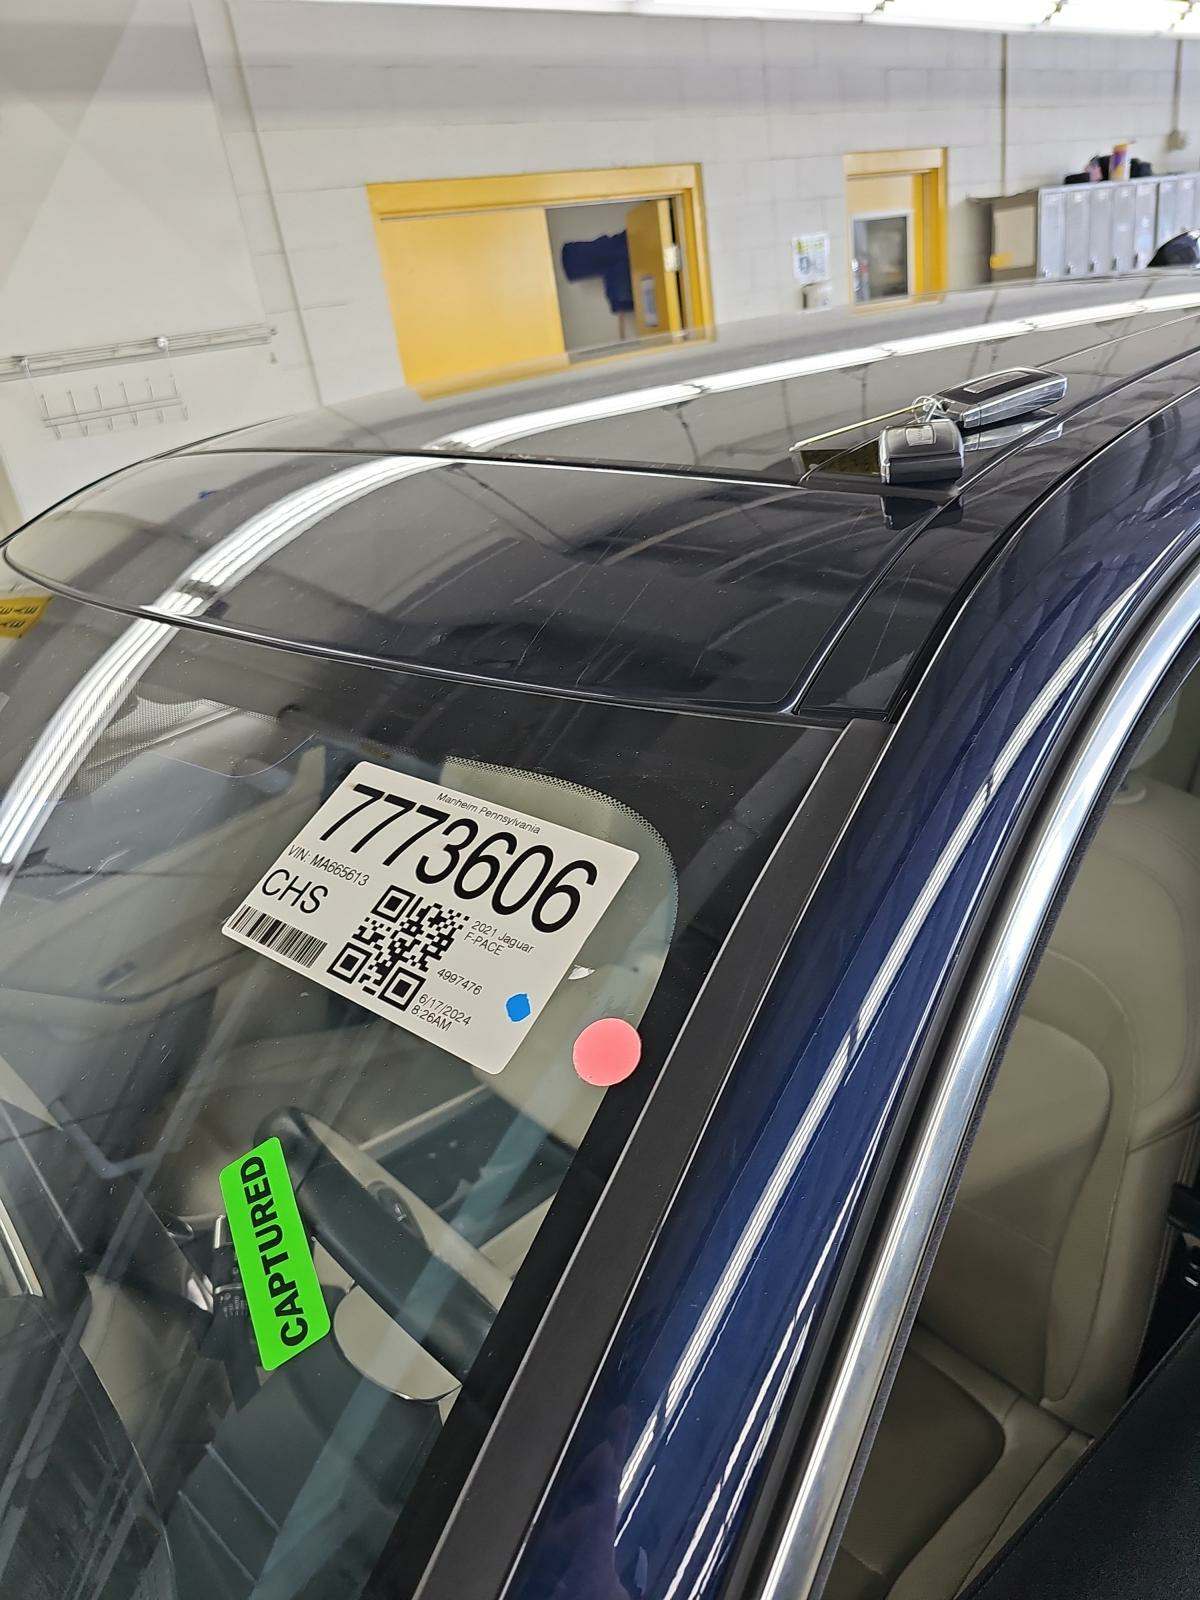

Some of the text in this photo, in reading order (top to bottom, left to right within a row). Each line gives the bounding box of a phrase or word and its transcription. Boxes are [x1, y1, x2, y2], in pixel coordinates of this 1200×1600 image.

[437, 793, 541, 834] Manheim Pennsylvania
[288, 844, 370, 886] VIN: MA665613
[319, 783, 598, 934] 7773606
[261, 868, 329, 914] CHS
[463, 931, 505, 956] F-PACE
[471, 920, 536, 954] 2021 Jaguar
[437, 968, 483, 996] 4997476
[411, 1004, 452, 1032] 8:26AM
[419, 993, 472, 1026] 6/17/2024
[240, 1156, 309, 1348] CAPTURED
